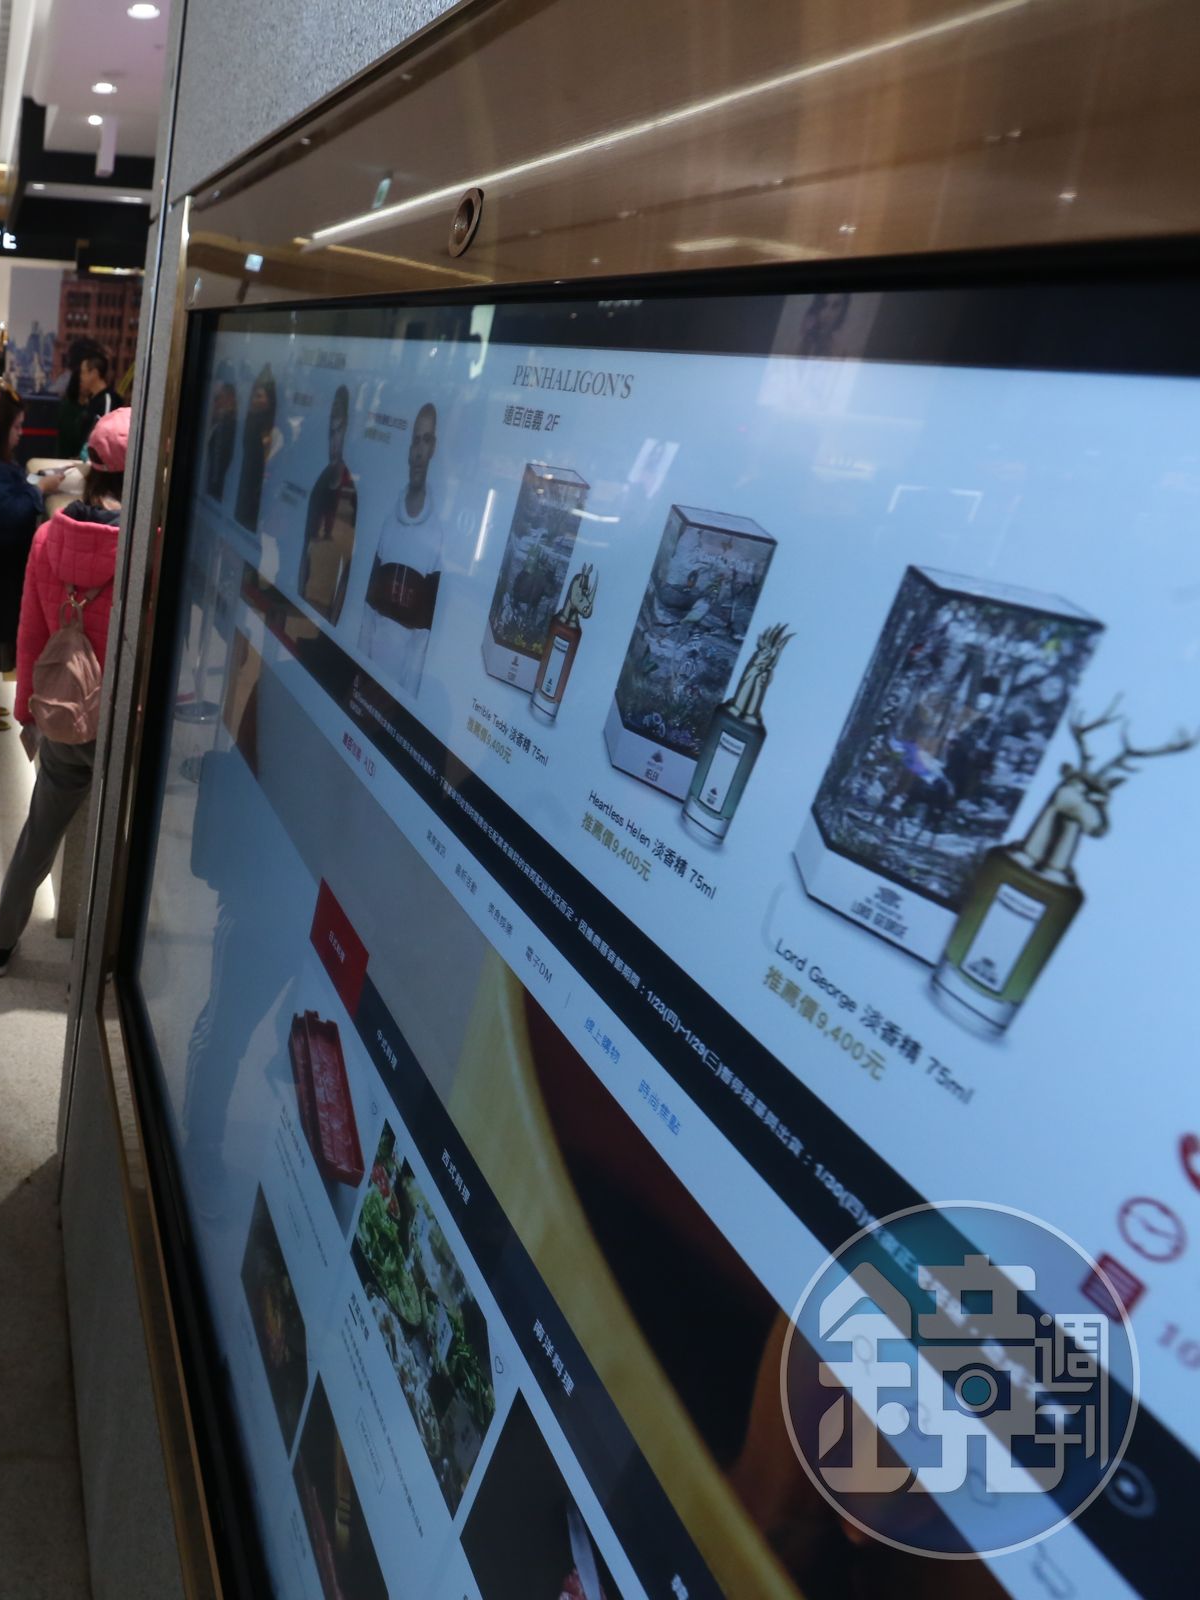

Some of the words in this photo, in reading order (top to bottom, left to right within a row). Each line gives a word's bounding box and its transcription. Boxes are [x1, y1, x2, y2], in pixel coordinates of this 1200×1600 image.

[512, 364, 634, 399] PENHALIGON'S
[544, 413, 561, 432] 2F
[531, 745, 549, 767] 75ml
[581, 810, 652, 882] 推薦價9,400元
[588, 790, 625, 827] Heartless
[625, 819, 651, 848] Helen
[651, 839, 688, 878] 淡香精
[688, 868, 717, 900] 75ml
[763, 964, 886, 1082] 推薦價9,400元
[774, 938, 808, 972] Lord
[808, 966, 858, 1013] George
[859, 1003, 923, 1065] 淡香精
[925, 1056, 975, 1105] 75ml
